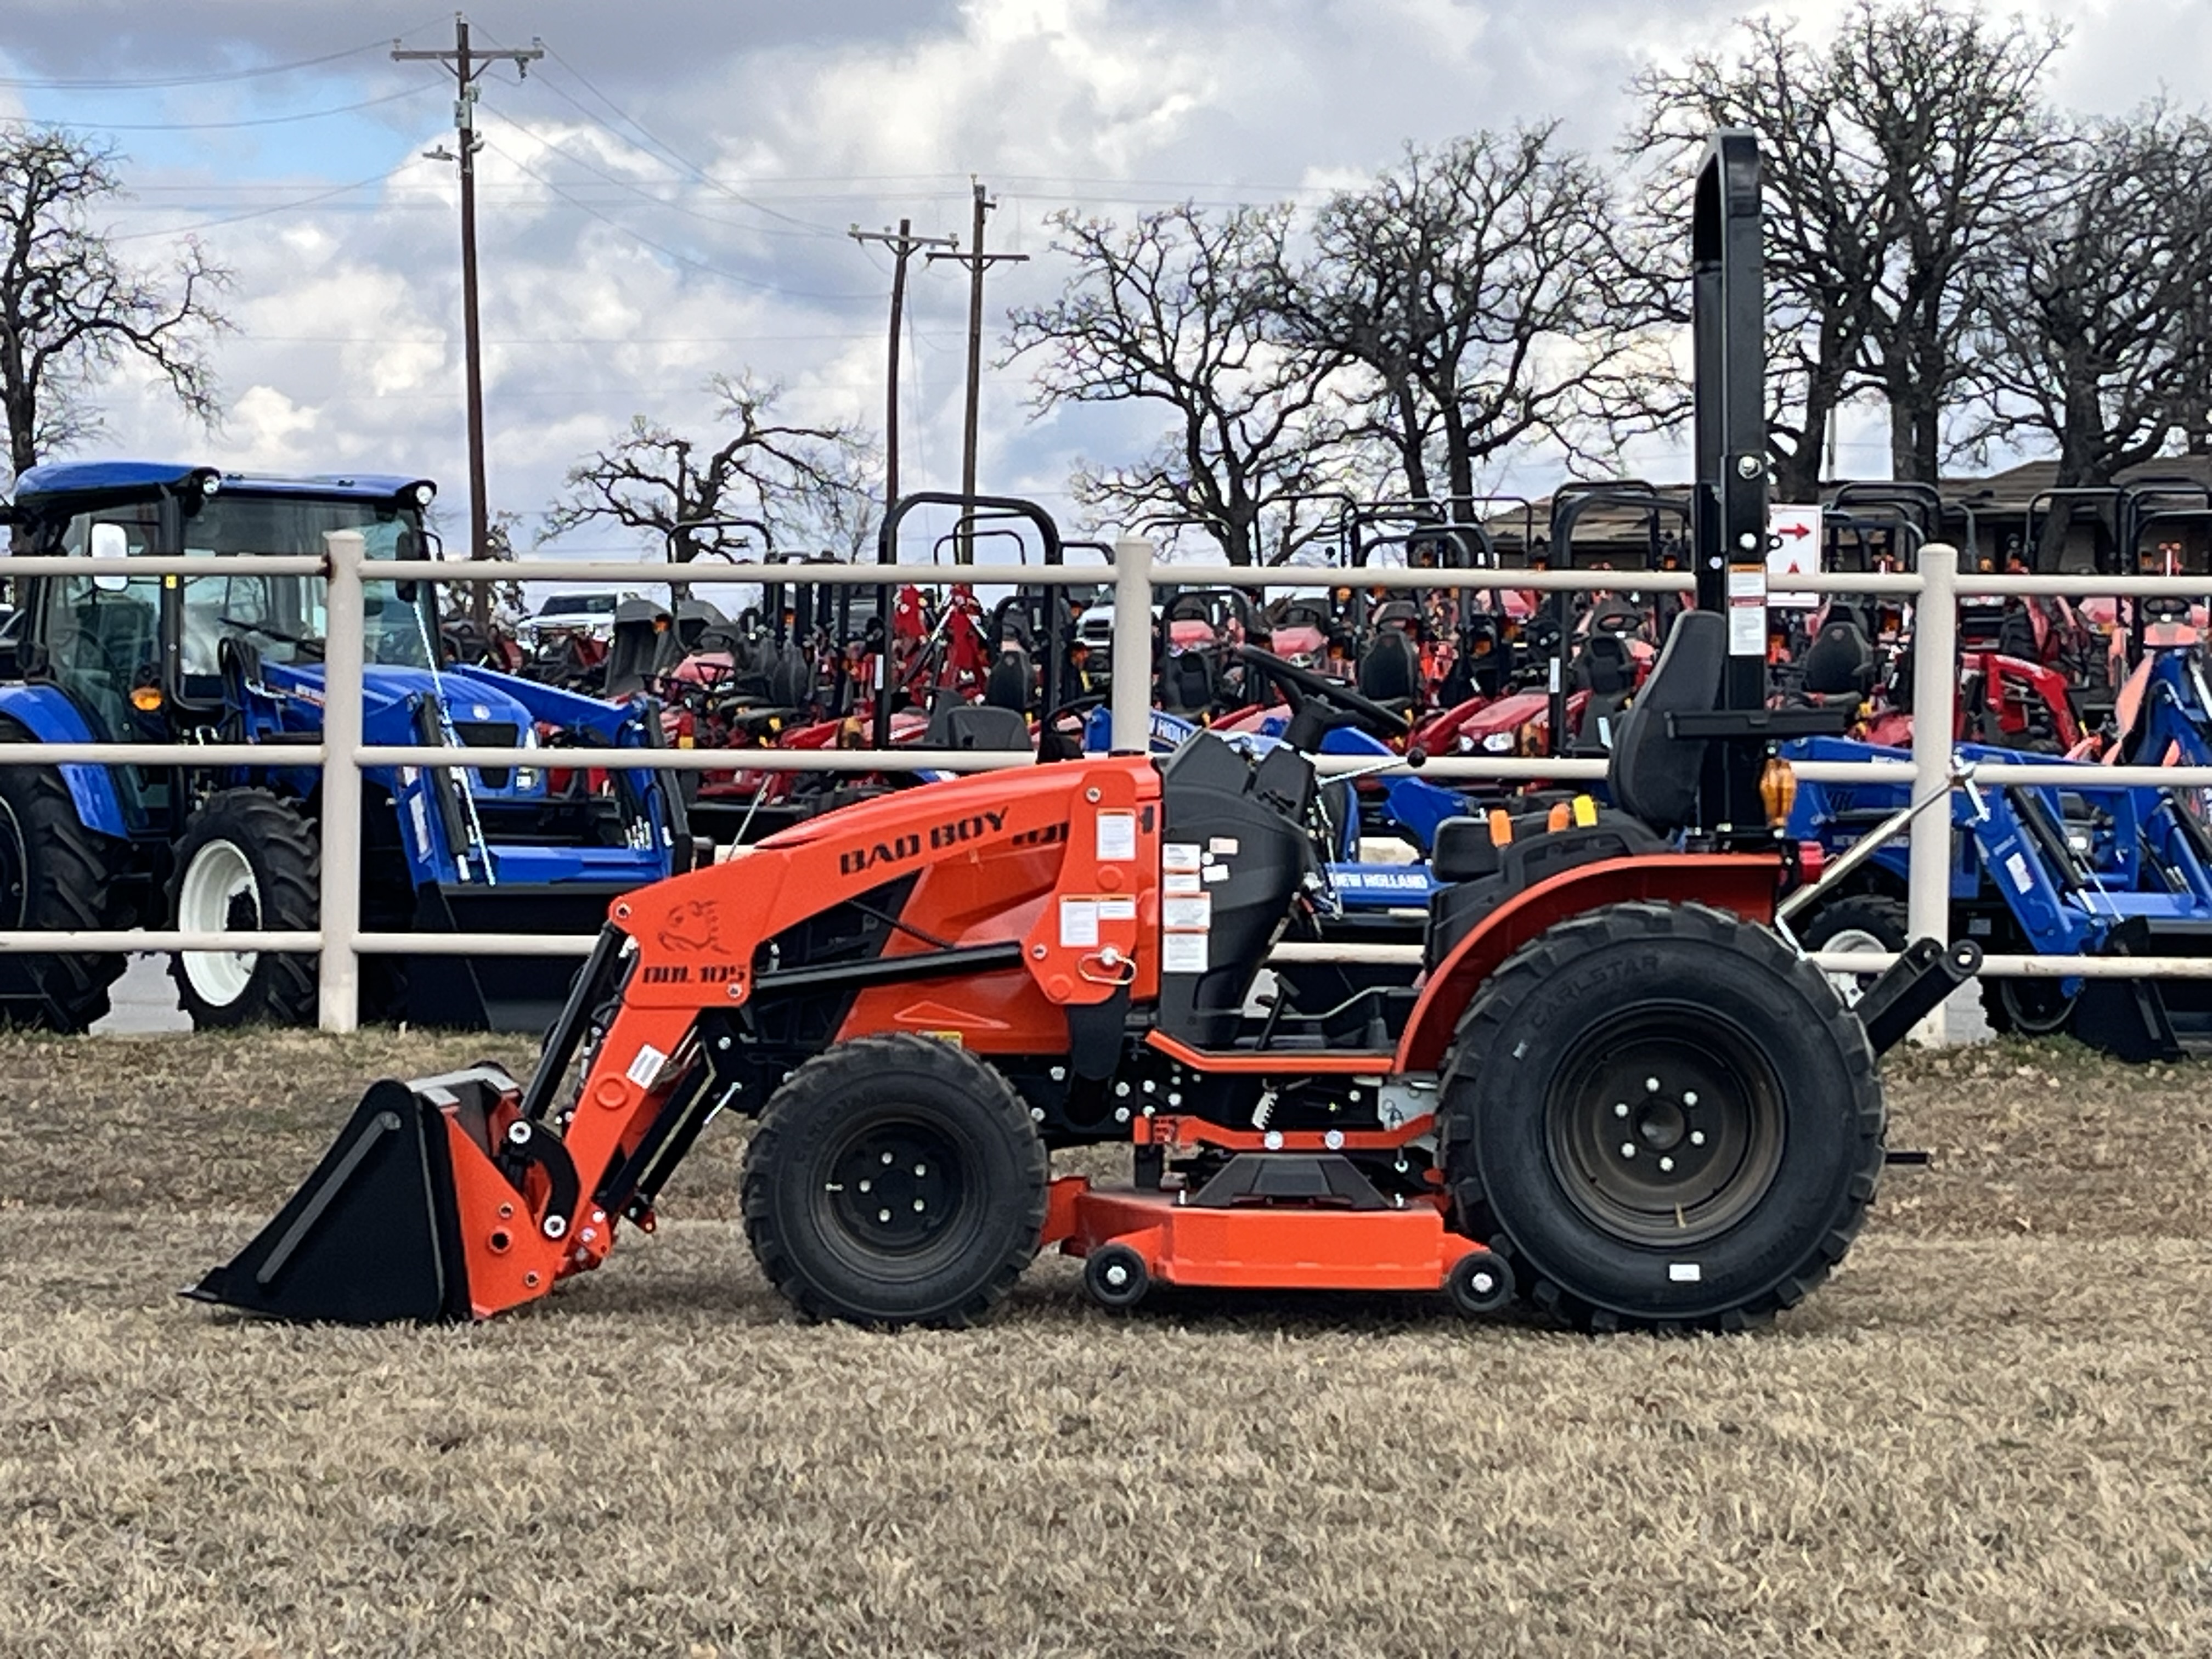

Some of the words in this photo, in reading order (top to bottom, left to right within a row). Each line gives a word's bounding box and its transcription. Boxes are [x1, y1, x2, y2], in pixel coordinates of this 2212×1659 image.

[840, 834, 920, 876] BAD
[930, 806, 1009, 850] BOY
[1362, 873, 1428, 889] HOLLAND
[1533, 956, 1659, 1029] CARLSTAR
